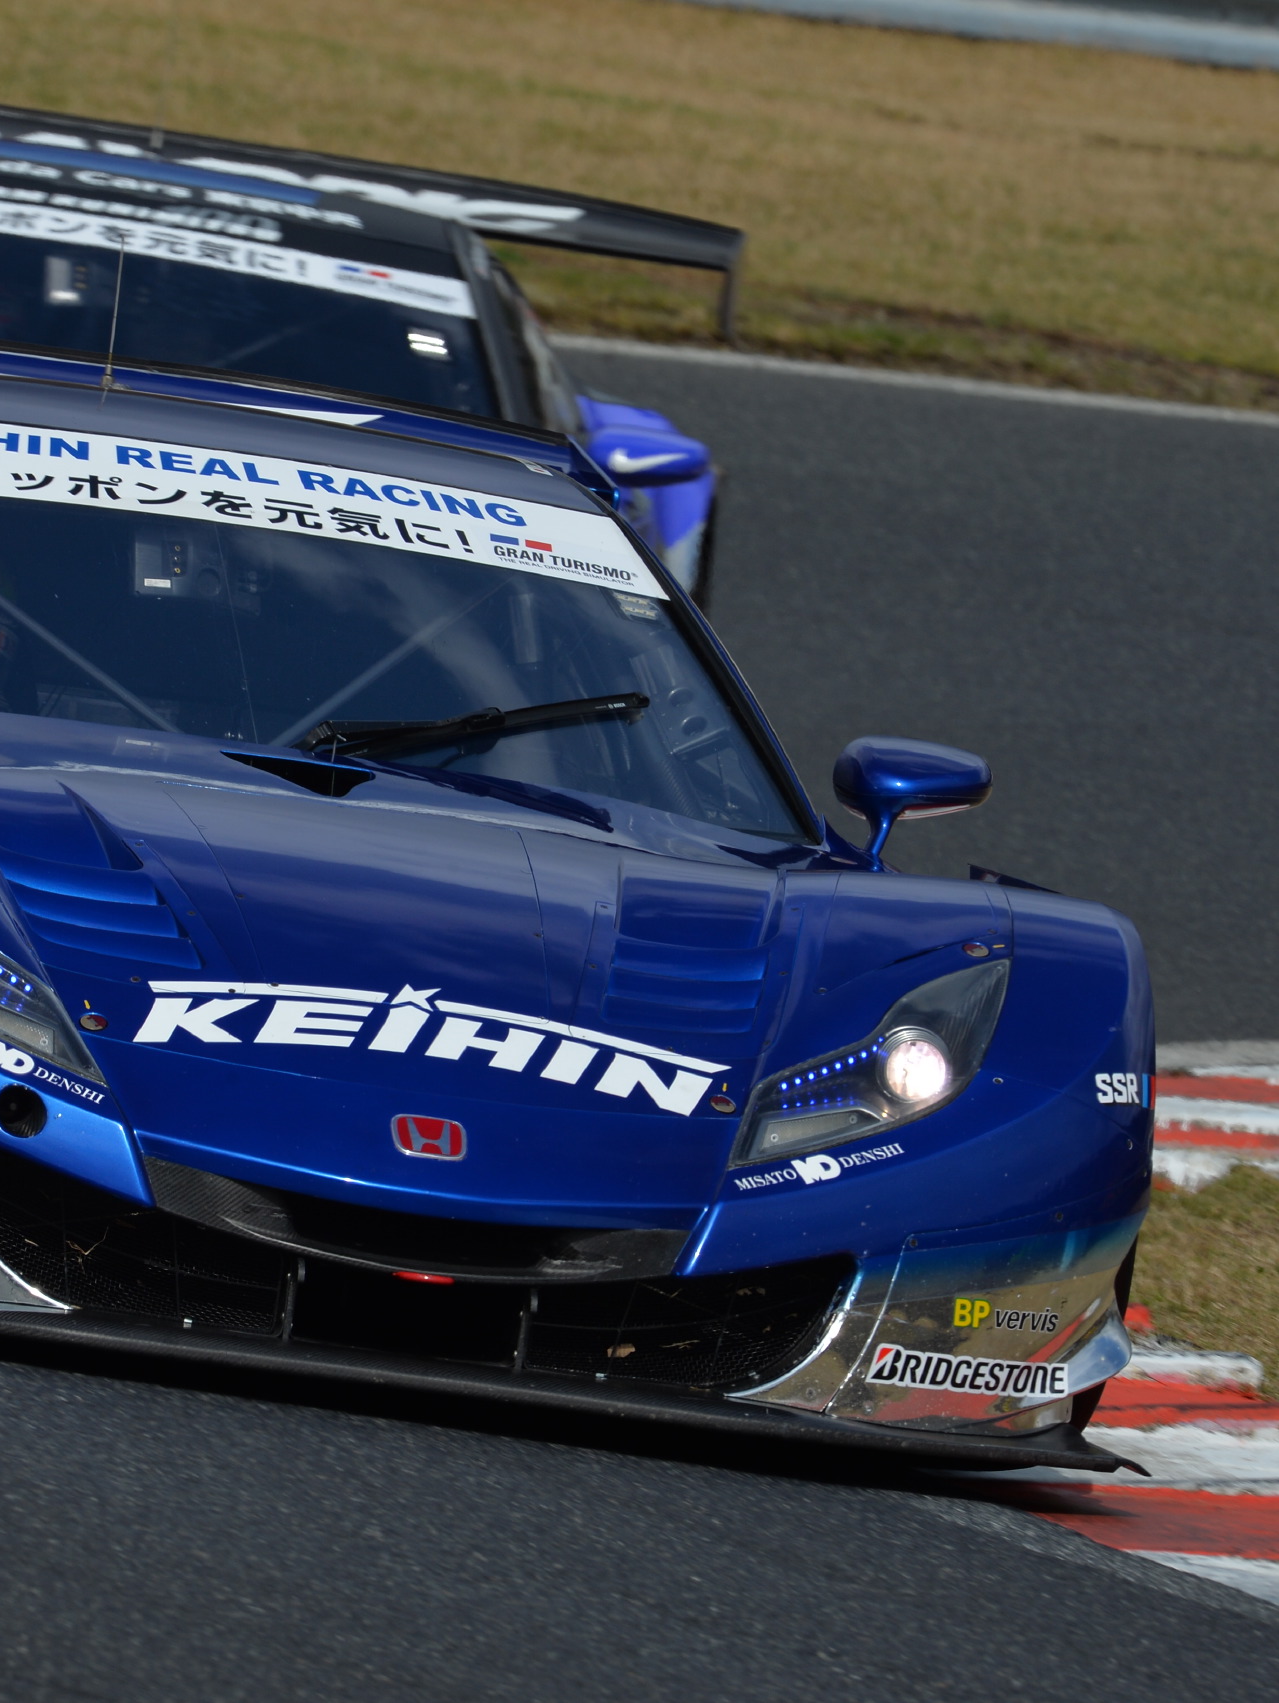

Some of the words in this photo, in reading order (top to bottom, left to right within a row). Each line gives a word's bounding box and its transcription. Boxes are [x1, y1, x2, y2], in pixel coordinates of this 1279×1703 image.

[73, 170, 192, 198] Cars
[116, 445, 279, 485] REAL
[297, 469, 527, 526] RACING
[493, 545, 544, 564] GRAN
[519, 560, 541, 568] REAL
[544, 564, 581, 576] DRIVING
[583, 572, 635, 587] SIMULATOR
[133, 984, 714, 1117] KEIHIN
[33, 1066, 106, 1105] DENSHI
[1095, 1073, 1140, 1104] SSR
[734, 1168, 797, 1191] MISATO
[837, 1143, 906, 1169] DENSHI
[954, 1298, 991, 1329] BP
[994, 1308, 1059, 1333] vervis
[869, 1346, 1067, 1395] BRIDGESTONE
